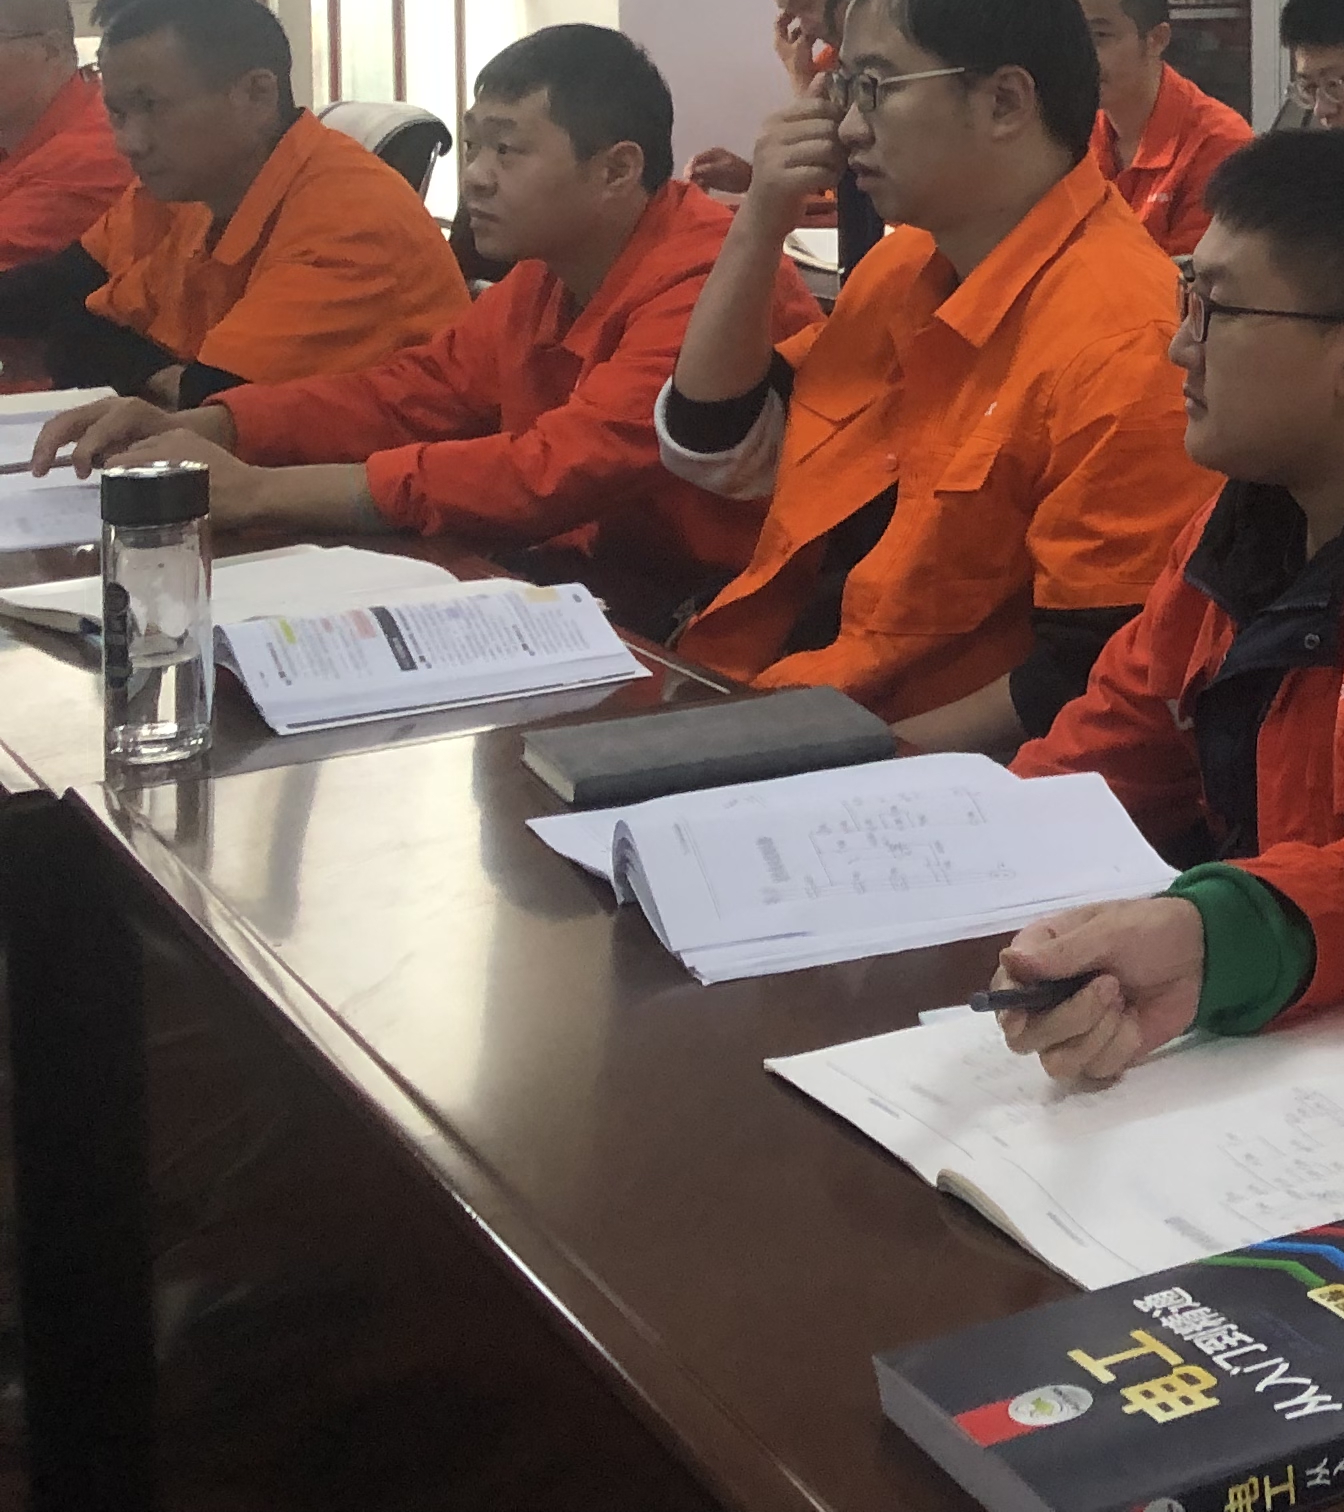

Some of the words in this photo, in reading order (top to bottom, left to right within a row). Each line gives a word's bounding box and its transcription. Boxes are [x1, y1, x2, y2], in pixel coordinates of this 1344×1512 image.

[1067, 1328, 1221, 1424] 电工
[1133, 1287, 1343, 1420] 从入门到精通
[1223, 1464, 1297, 1512] 电工
